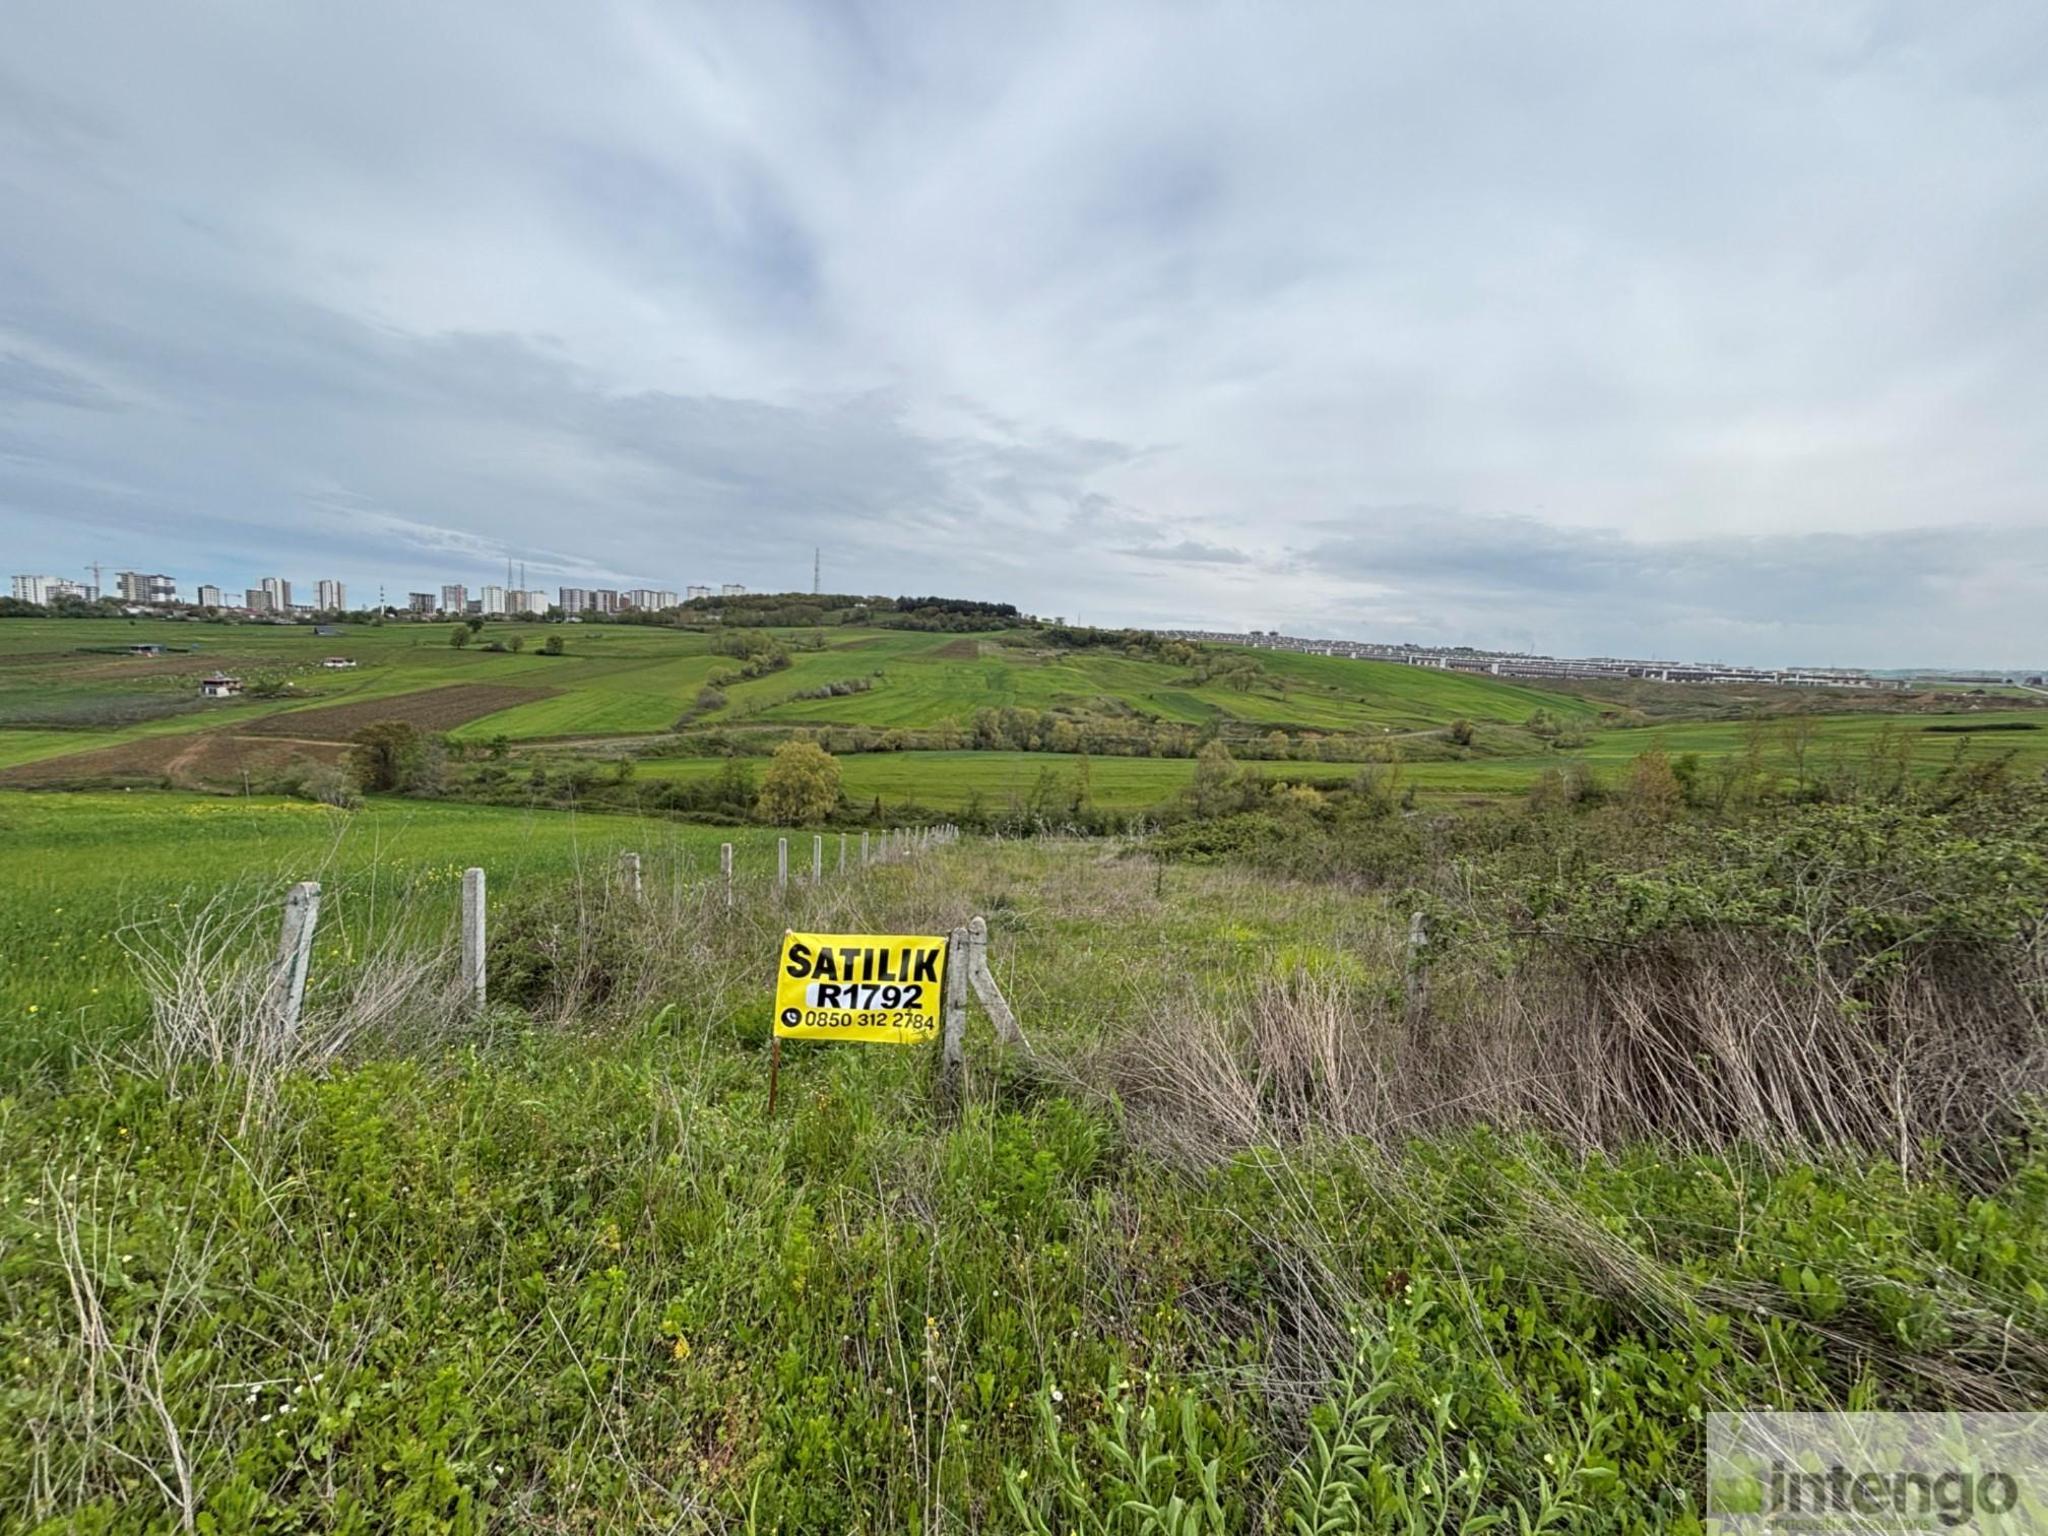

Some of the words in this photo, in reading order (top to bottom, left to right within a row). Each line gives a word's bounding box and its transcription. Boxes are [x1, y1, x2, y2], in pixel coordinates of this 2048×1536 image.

[786, 943, 940, 983] SATILIK
[816, 984, 923, 1010] R1792
[805, 1010, 851, 1027] 0850
[857, 1013, 887, 1026] 312
[892, 1012, 934, 1030] 2784
